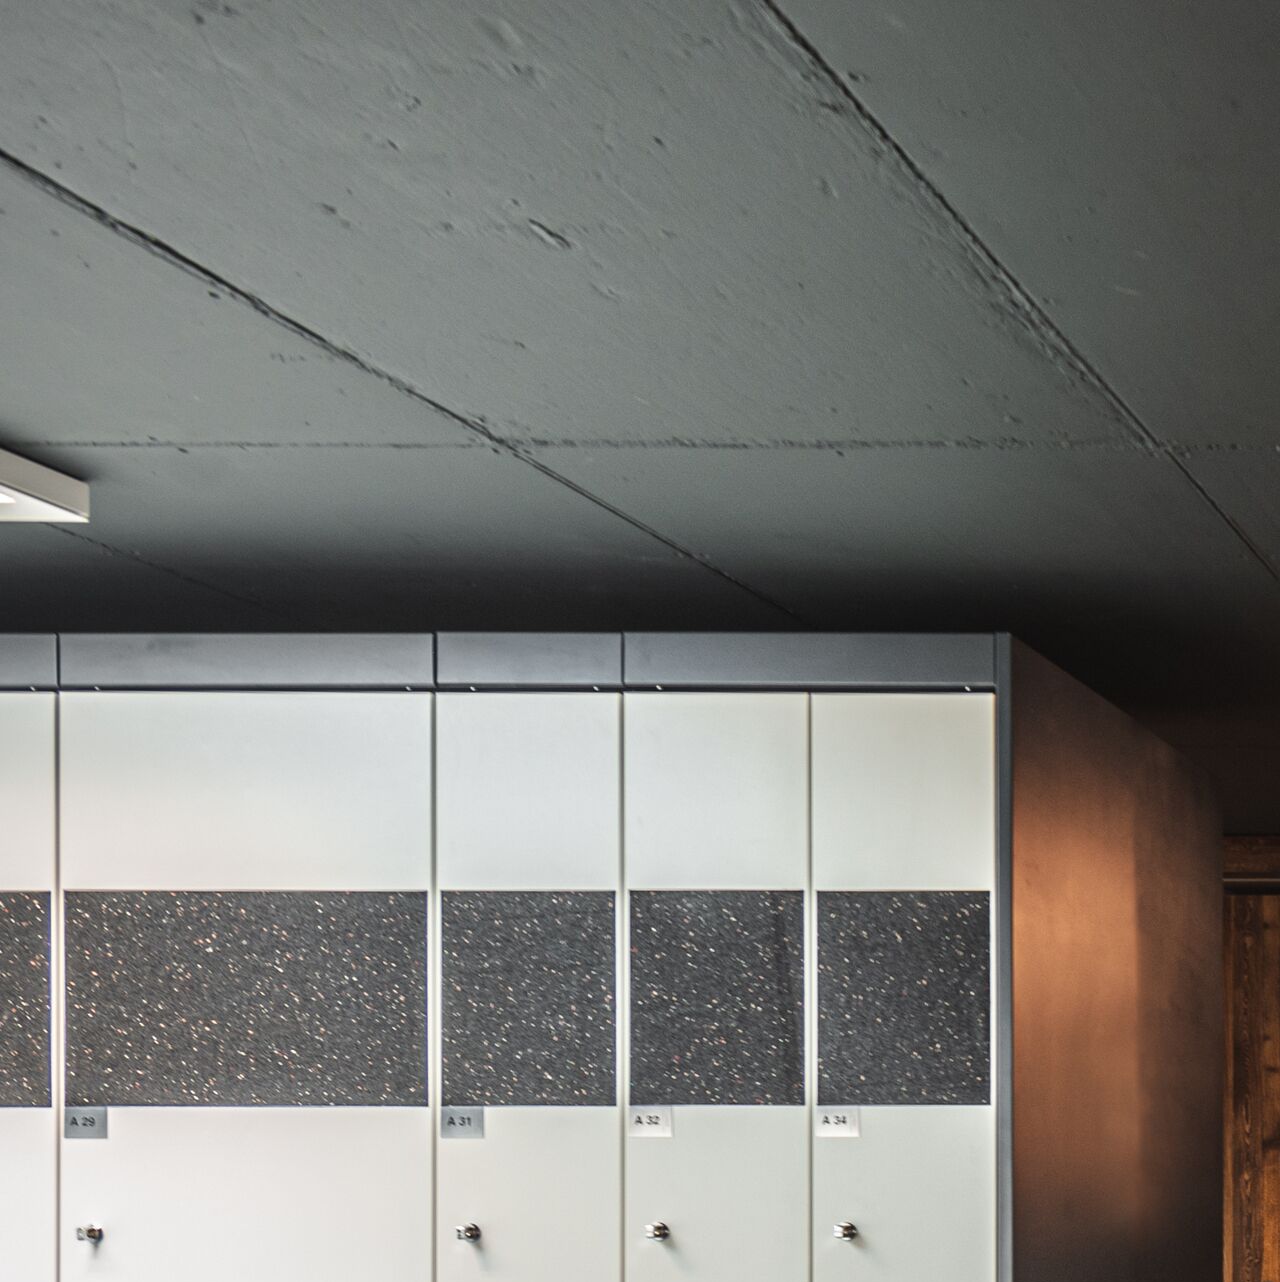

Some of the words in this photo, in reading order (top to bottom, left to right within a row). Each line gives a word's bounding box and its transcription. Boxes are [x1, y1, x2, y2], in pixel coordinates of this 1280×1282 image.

[69, 1117, 79, 1127] A
[81, 1117, 96, 1127] 29
[447, 1117, 456, 1127] A
[458, 1116, 472, 1127] 31
[634, 1116, 644, 1126] A
[646, 1115, 660, 1126] 32
[821, 1115, 831, 1126] A
[833, 1114, 848, 1126] 34
